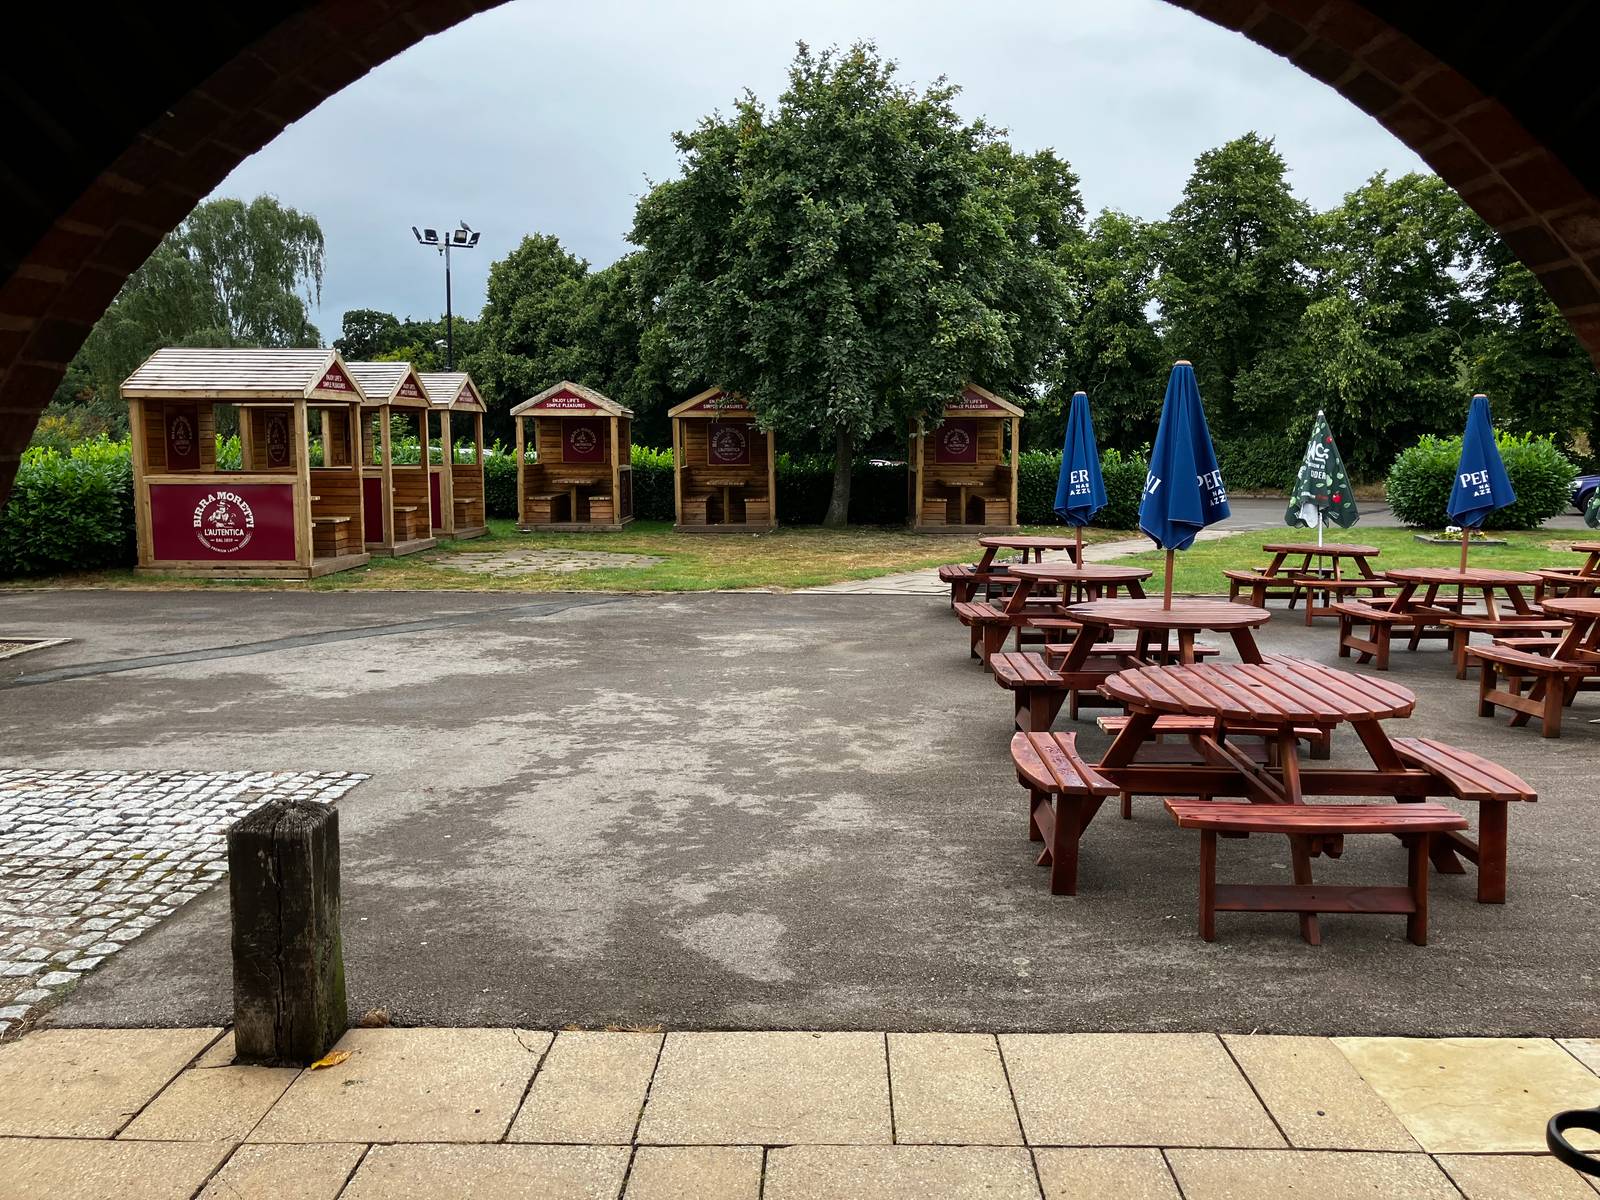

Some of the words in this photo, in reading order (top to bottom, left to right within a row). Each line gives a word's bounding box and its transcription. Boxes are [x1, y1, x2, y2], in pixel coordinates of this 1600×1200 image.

[193, 493, 217, 528] BIRRA
[216, 491, 255, 528] MORETTI
[204, 528, 244, 536] L'AUTENTICA
